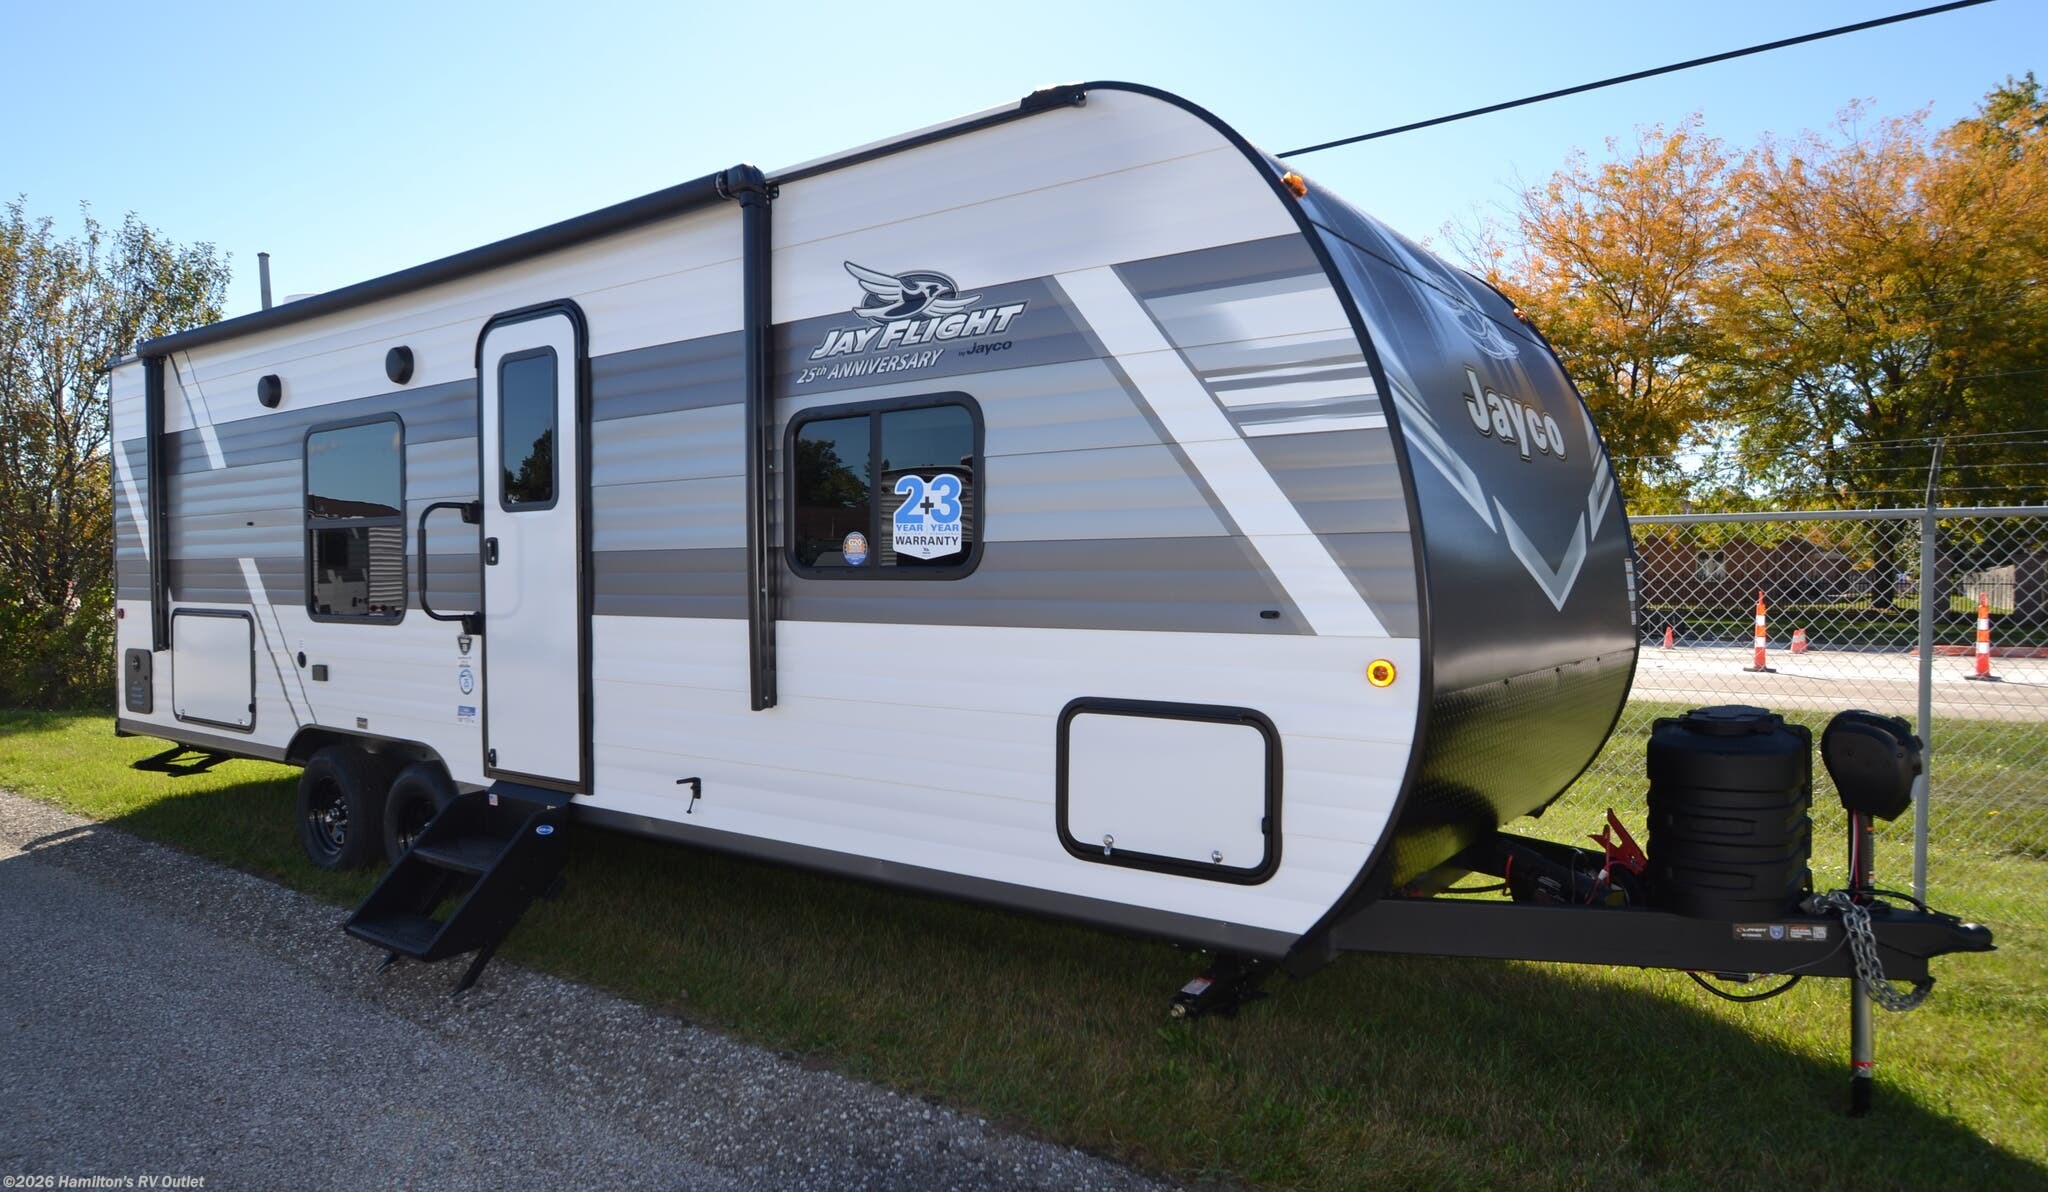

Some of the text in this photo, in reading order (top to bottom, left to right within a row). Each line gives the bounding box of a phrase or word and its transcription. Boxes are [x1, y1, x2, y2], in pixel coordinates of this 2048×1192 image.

[809, 301, 1027, 361] JAY FLIGHT
[966, 341, 1012, 356] Jayco
[796, 348, 945, 385] 25th ANNIVERSARY
[1463, 365, 1567, 463] Jayco
[895, 535, 959, 546] WARRANTY
[896, 523, 960, 532] YEAR YEAR
